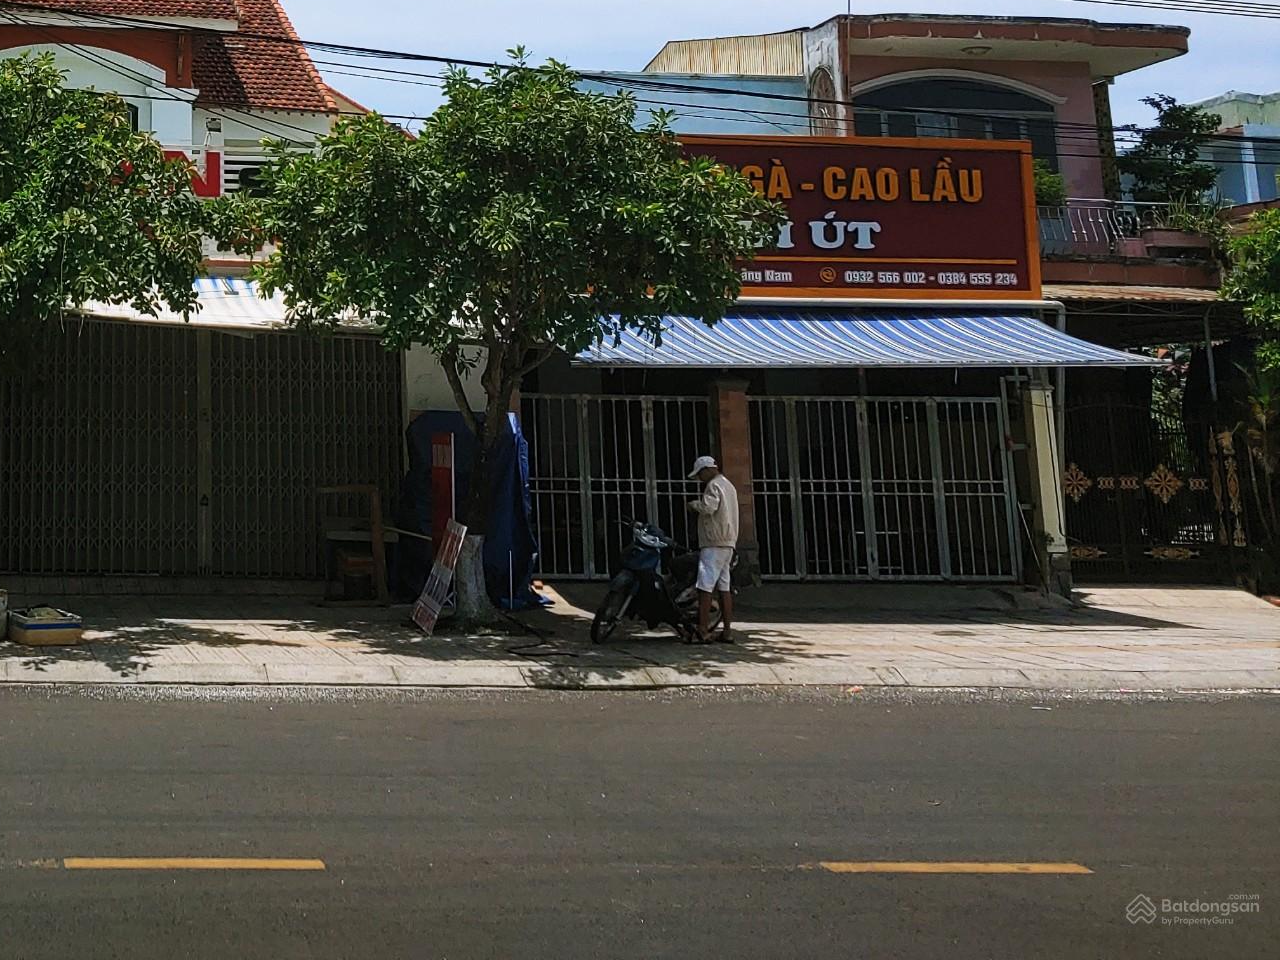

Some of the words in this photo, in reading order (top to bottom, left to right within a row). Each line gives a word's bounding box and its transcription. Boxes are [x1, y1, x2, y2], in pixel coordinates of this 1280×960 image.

[823, 166, 899, 201] CAO
[910, 157, 983, 203] LẦU
[808, 210, 882, 250] ÚT
[764, 269, 793, 283] Nam
[844, 270, 874, 283] 0932
[877, 271, 900, 283] 566
[903, 271, 926, 284] 002
[937, 272, 967, 284] 0384
[969, 272, 992, 285] 555
[994, 273, 1018, 286] 234
